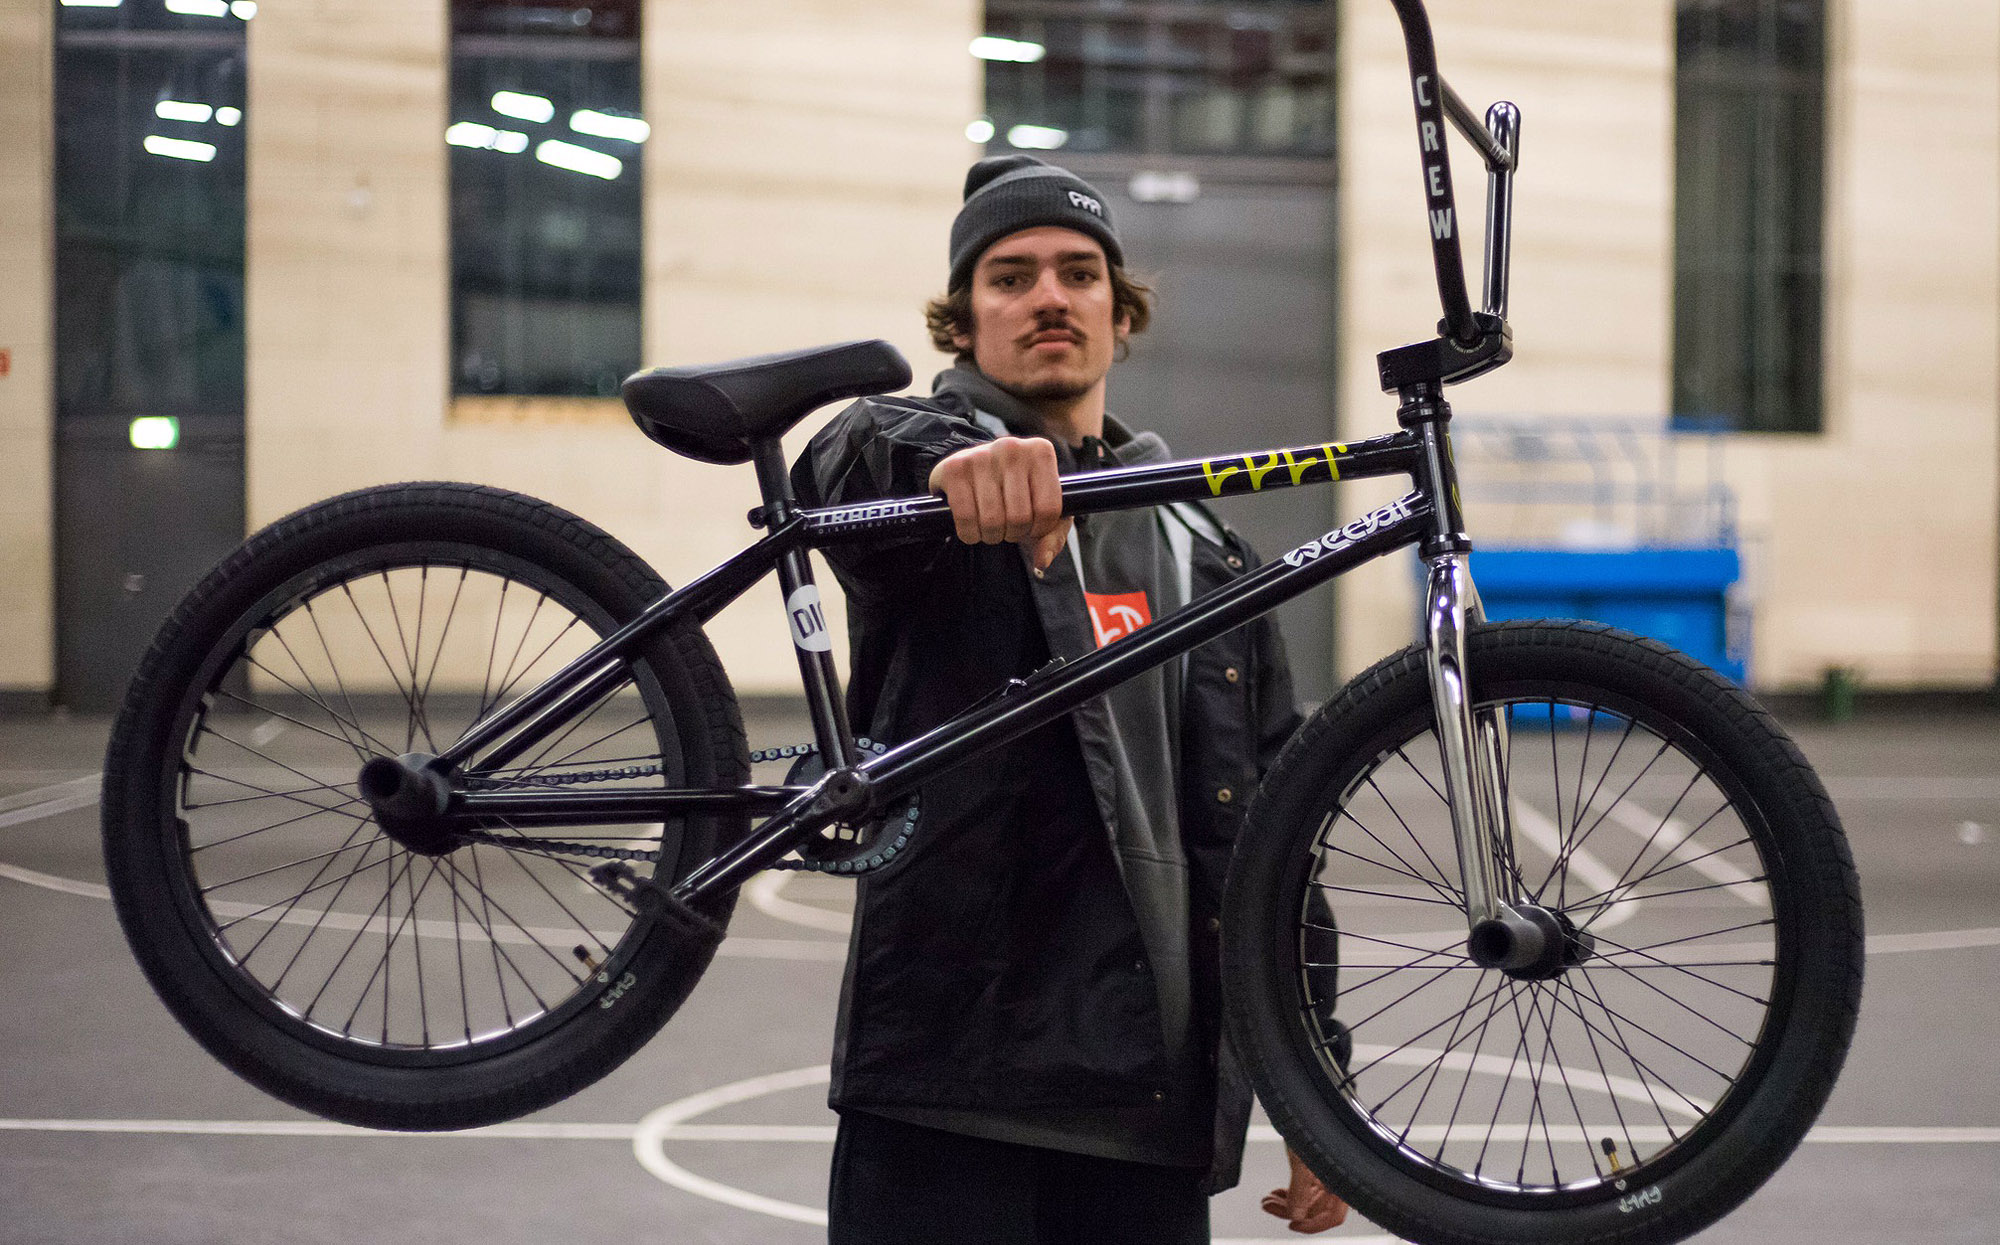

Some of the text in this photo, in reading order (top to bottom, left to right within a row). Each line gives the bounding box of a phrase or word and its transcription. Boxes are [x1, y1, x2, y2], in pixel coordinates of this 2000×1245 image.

[1415, 74, 1452, 240] CREW
[818, 517, 917, 535] DISTRIBUTION
[819, 502, 918, 526] TRAFFIC
[792, 601, 827, 639] DI
[1618, 1185, 1662, 1213] CULT
